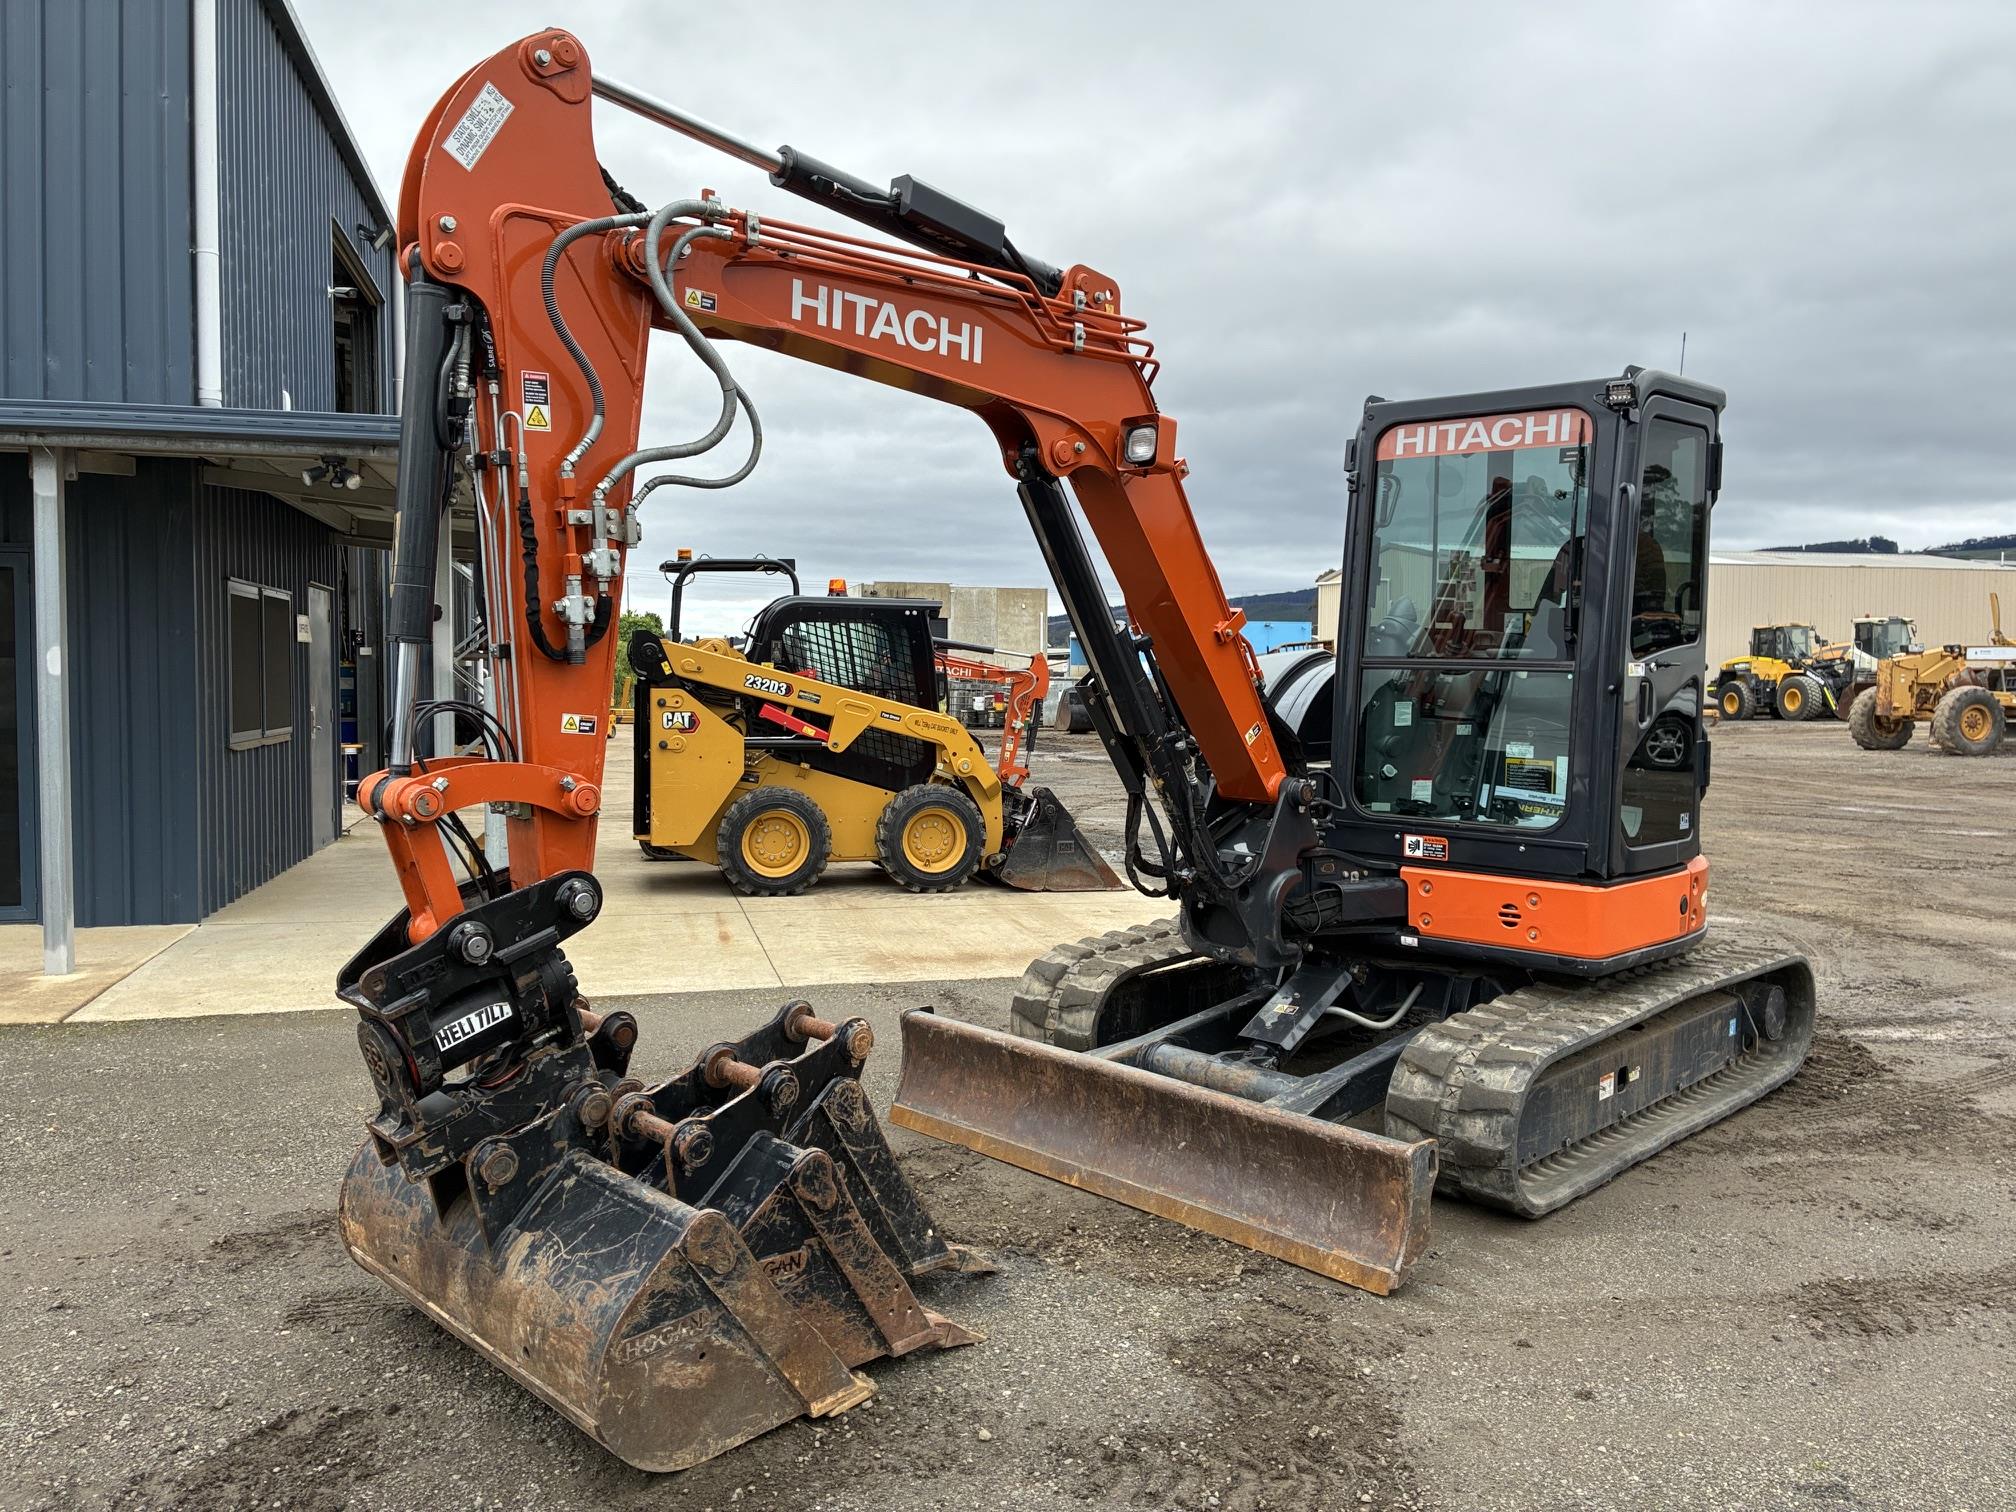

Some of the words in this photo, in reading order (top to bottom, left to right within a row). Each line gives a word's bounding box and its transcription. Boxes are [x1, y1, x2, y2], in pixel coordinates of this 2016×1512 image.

[452, 121, 469, 143] STATIC
[485, 85, 495, 96] KG
[455, 128, 477, 156] DYNAMIC
[492, 92, 502, 104] KG
[465, 148, 479, 167] REMOVE
[477, 131, 491, 149] BUCKET
[489, 118, 500, 133] WHEN
[498, 103, 511, 120] LIFTING
[469, 138, 480, 152] FROM
[478, 125, 489, 139] QUICK
[487, 112, 498, 126] HITCH
[495, 101, 505, 114] ONLY
[792, 278, 982, 364] HITACHI
[488, 345, 496, 368] SABRE
[1395, 412, 1571, 456] HITACHI
[745, 674, 787, 696] 232D3
[662, 711, 692, 729] CAT
[435, 1017, 475, 1050] HELI
[475, 1005, 505, 1030] TILT
[763, 1252, 802, 1276] GAN
